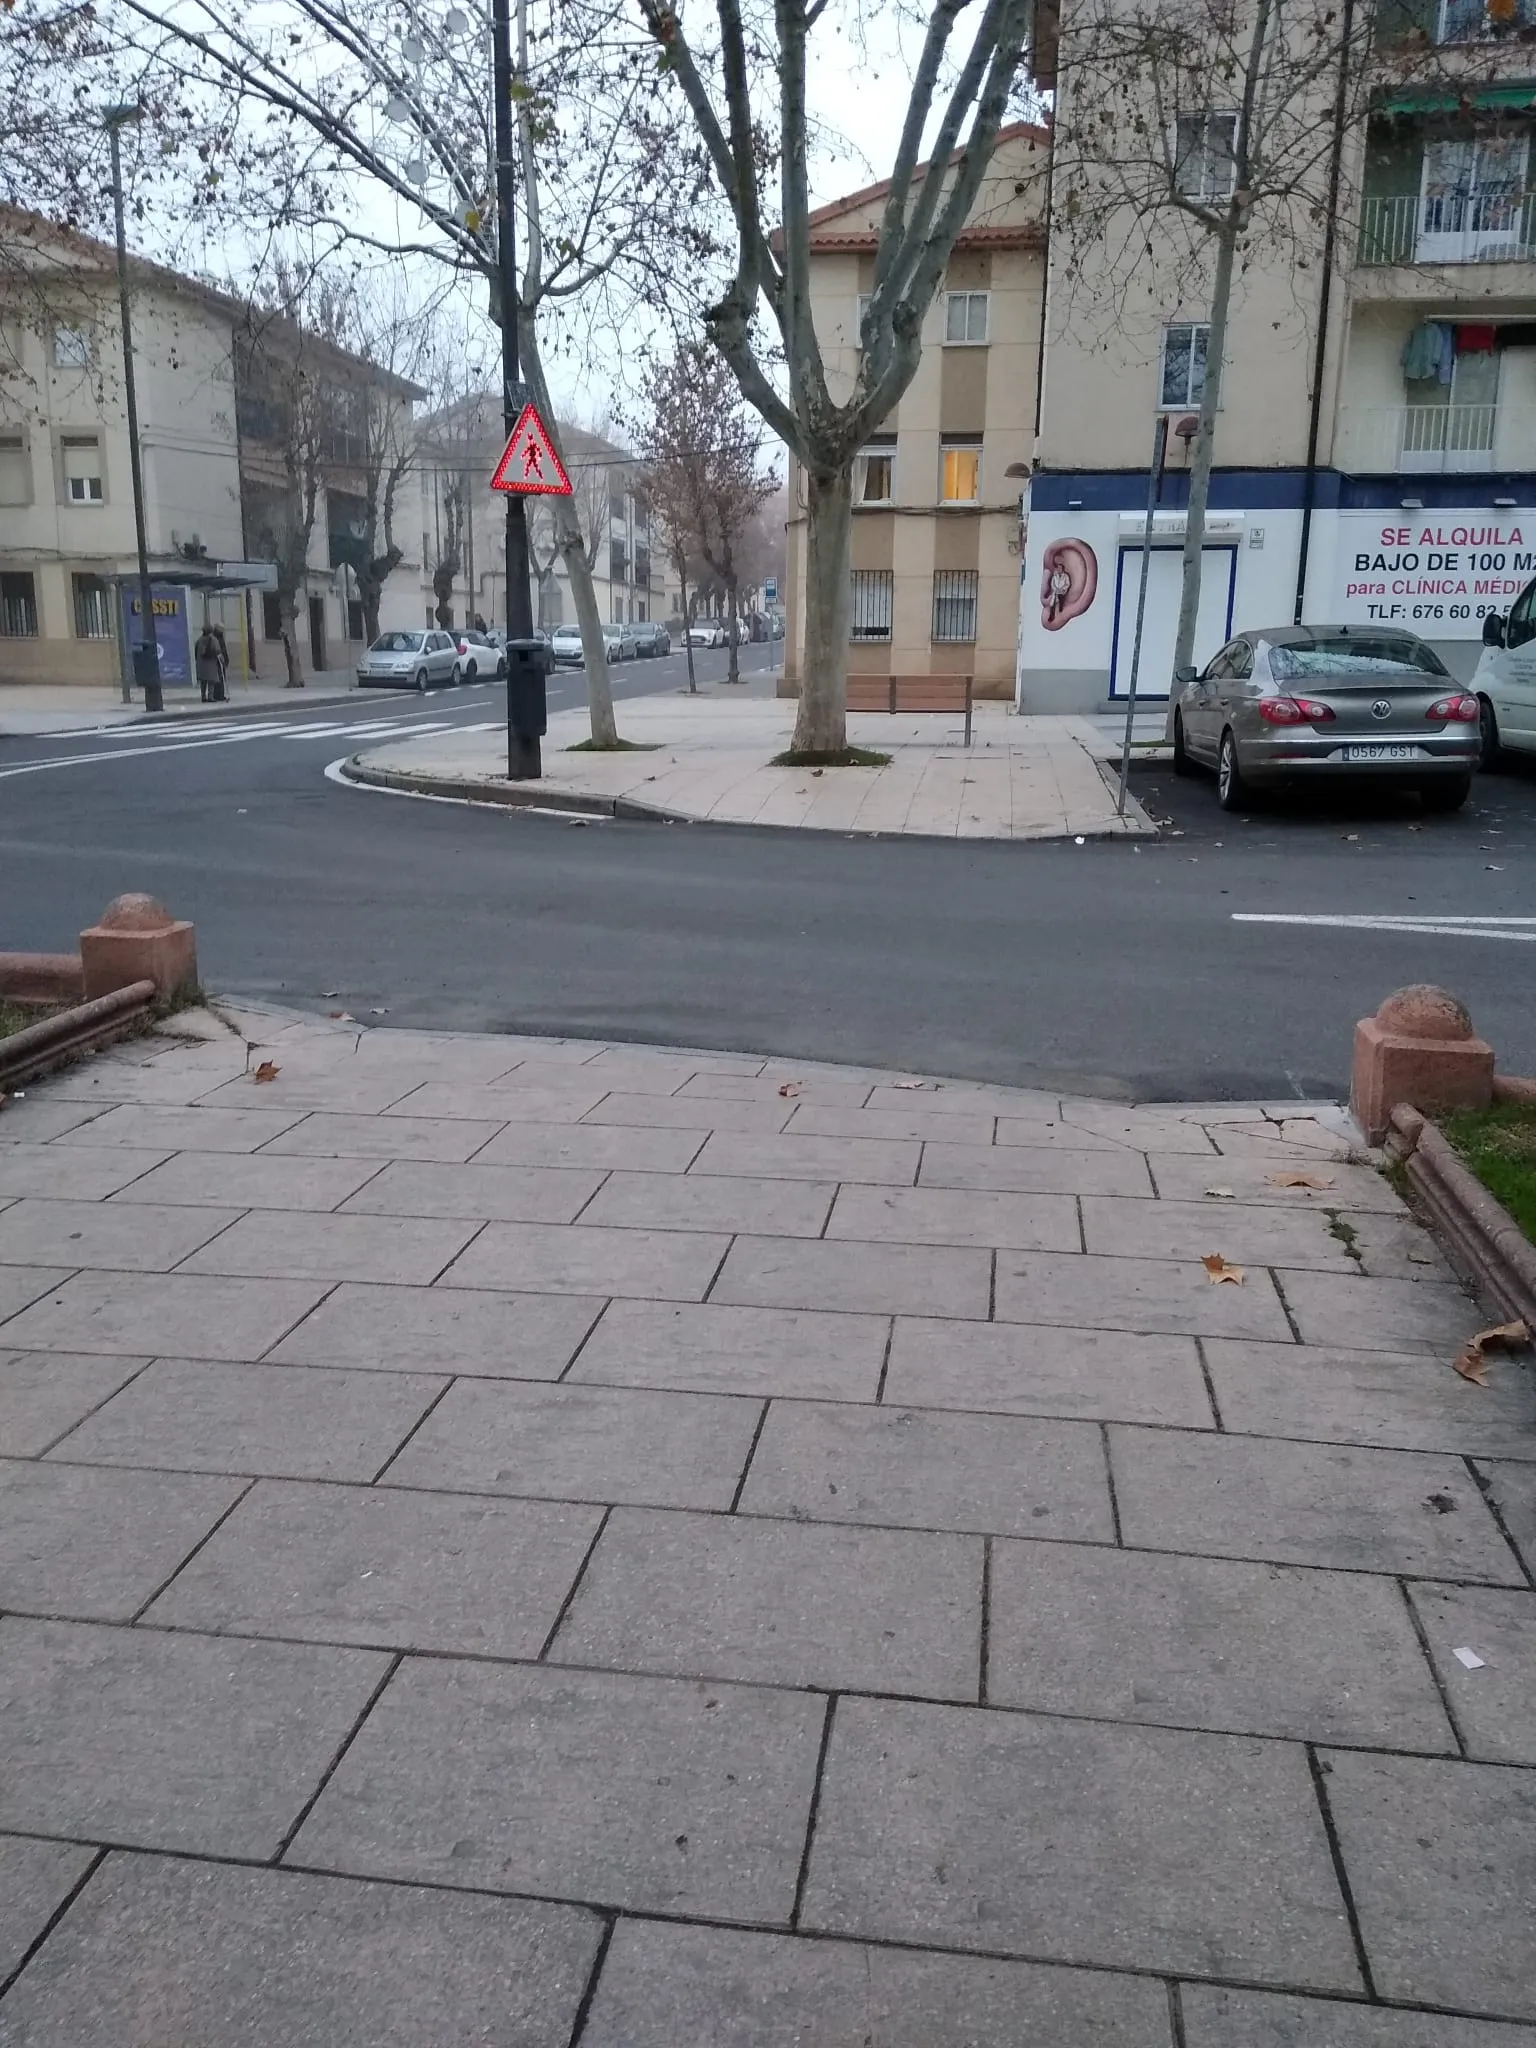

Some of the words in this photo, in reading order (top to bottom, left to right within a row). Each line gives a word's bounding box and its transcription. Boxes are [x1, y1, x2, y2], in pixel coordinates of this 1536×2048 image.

[1380, 528, 1411, 546] SE
[1418, 527, 1524, 546] ALQUILA
[1355, 553, 1419, 571] BAJO
[1427, 553, 1459, 571] DE
[1467, 553, 1505, 571] 100
[1346, 582, 1386, 598] para
[1391, 576, 1467, 595] CLÍNICA
[1367, 604, 1407, 619] TLF:
[1412, 604, 1443, 619] 676
[1449, 604, 1470, 619] 60
[1352, 746, 1385, 758] 0567
[1390, 746, 1415, 757] GST
